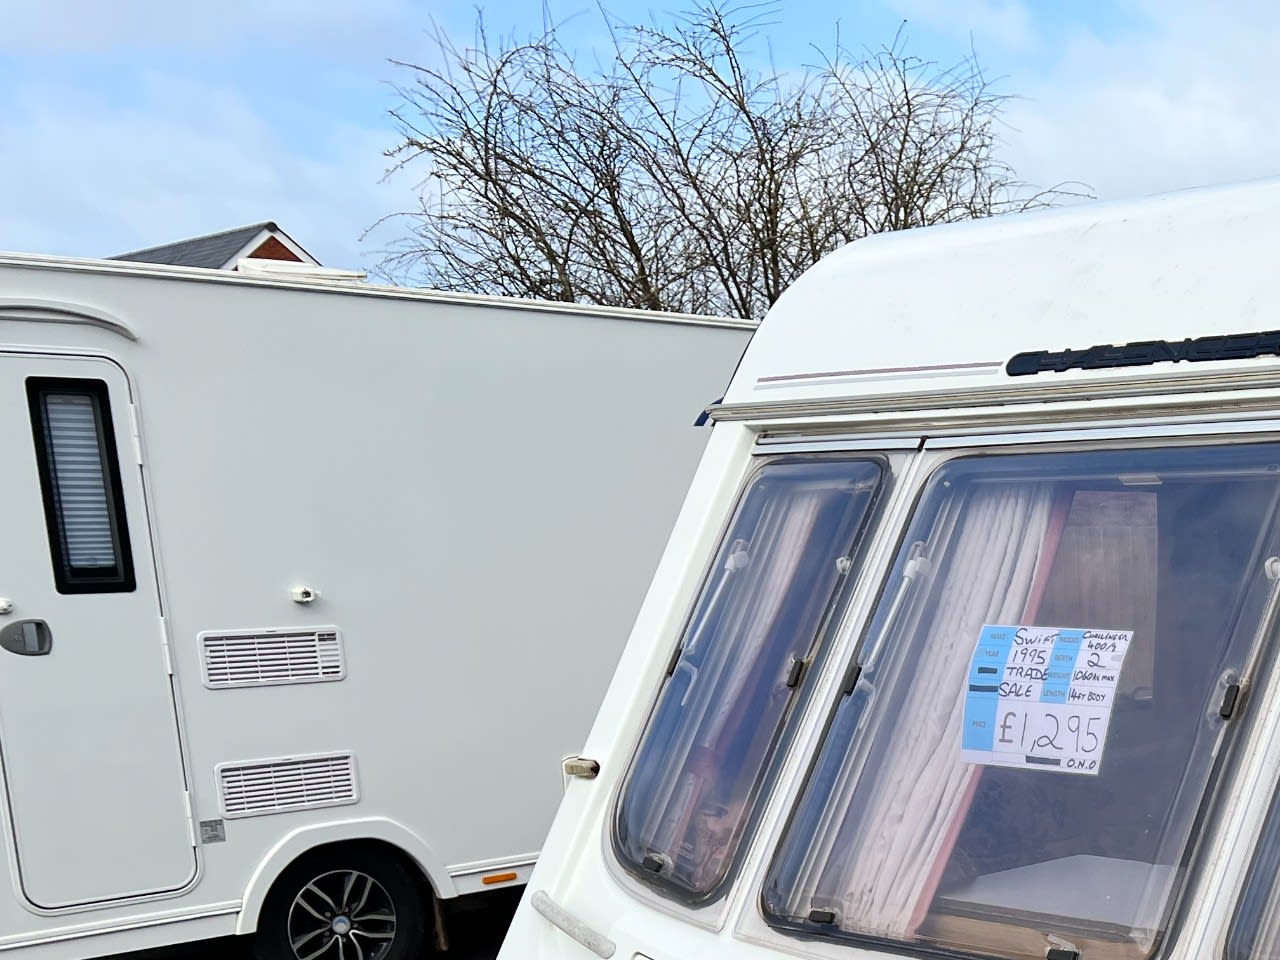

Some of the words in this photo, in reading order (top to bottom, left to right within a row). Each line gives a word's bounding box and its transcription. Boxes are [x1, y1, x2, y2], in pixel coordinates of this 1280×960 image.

[1012, 647, 1047, 664] 1995
[1087, 652, 1106, 668] 2
[1006, 666, 1049, 681] TRADE
[997, 681, 1033, 697] SALE
[1087, 691, 1106, 702] BODY
[998, 711, 1101, 753] £1,295
